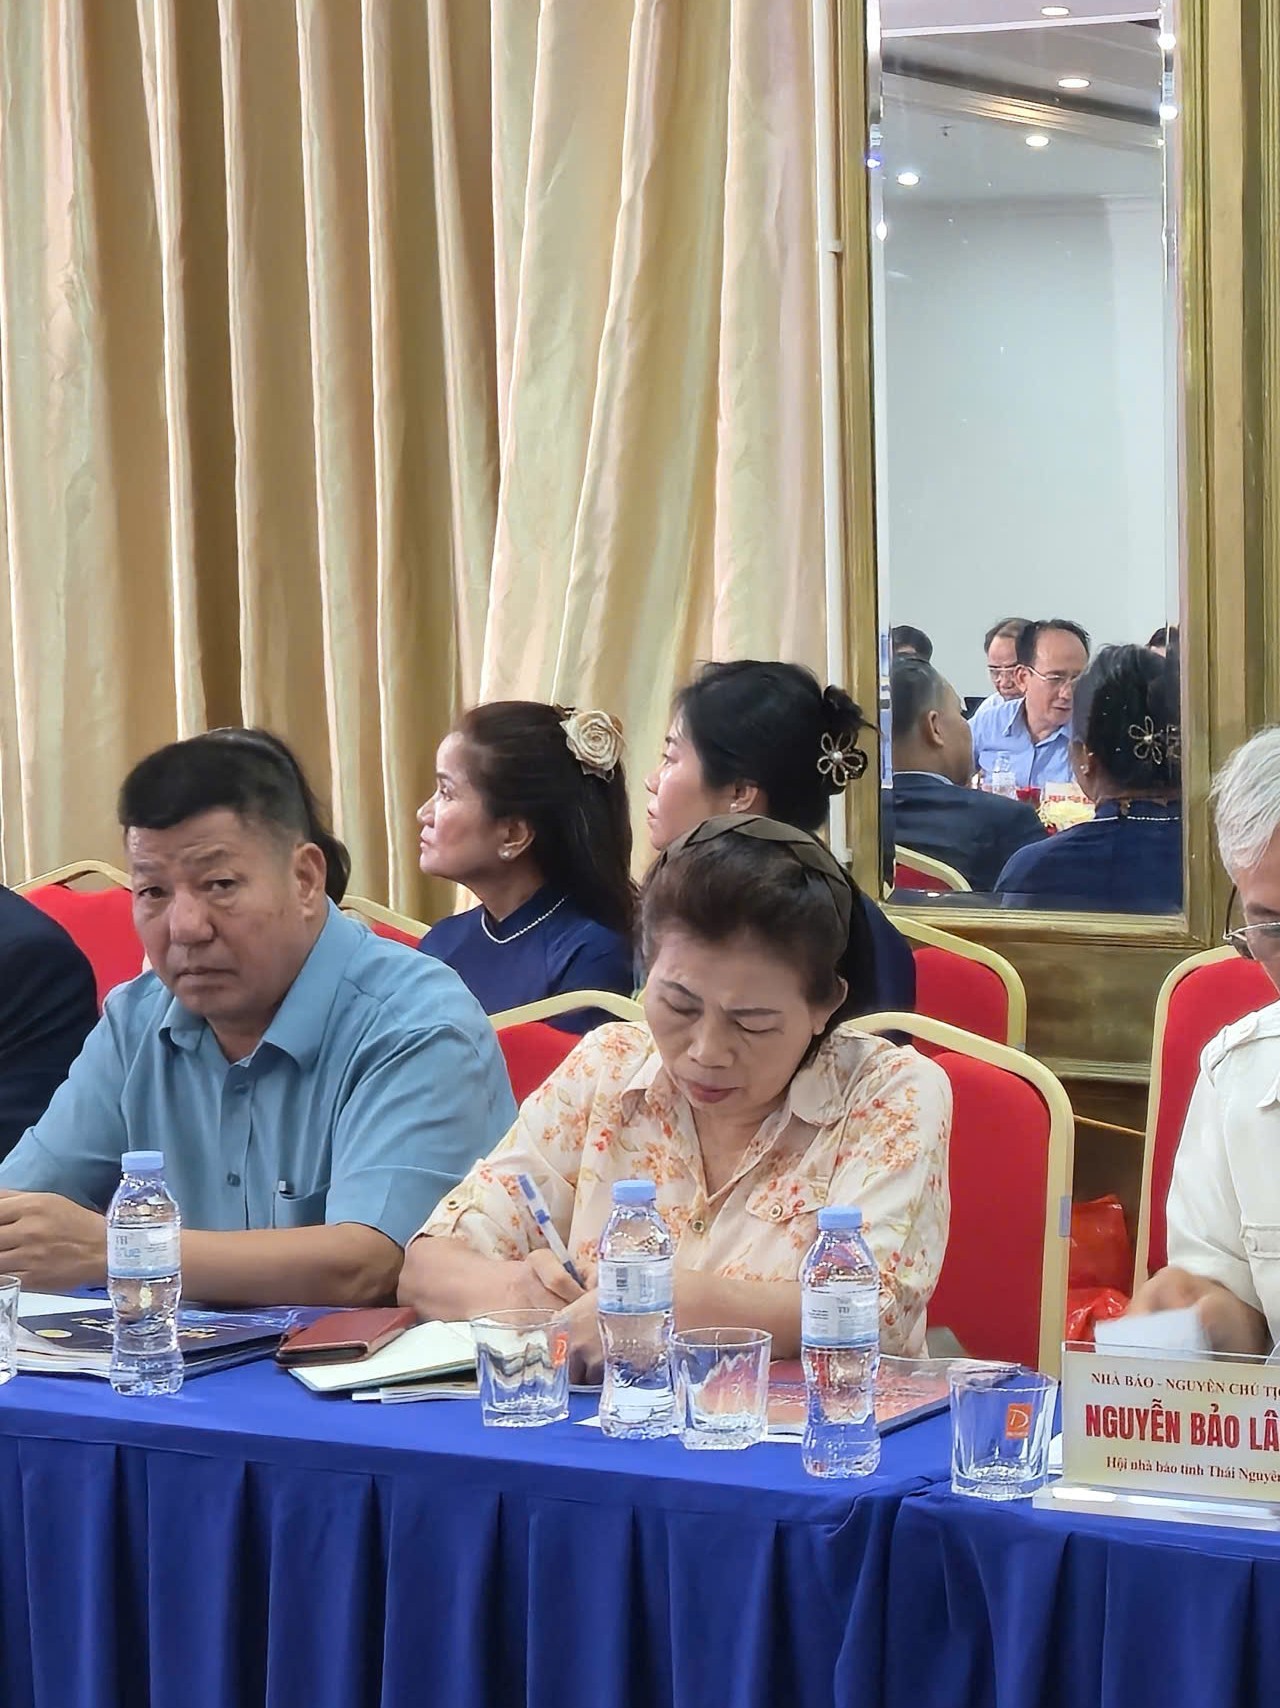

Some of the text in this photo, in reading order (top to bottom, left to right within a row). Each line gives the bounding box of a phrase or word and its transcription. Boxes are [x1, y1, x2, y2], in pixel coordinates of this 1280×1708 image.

[1091, 1371, 1120, 1386] NHÀ
[1125, 1373, 1154, 1389] BÁO
[1166, 1378, 1225, 1395] NGUYÊN
[1085, 1398, 1181, 1444] NGUYỄN
[1190, 1403, 1240, 1449] BẢO
[1106, 1456, 1128, 1472] Hội
[1130, 1458, 1153, 1472] nhà
[1156, 1460, 1178, 1474] báo
[1207, 1464, 1236, 1479] Thái
